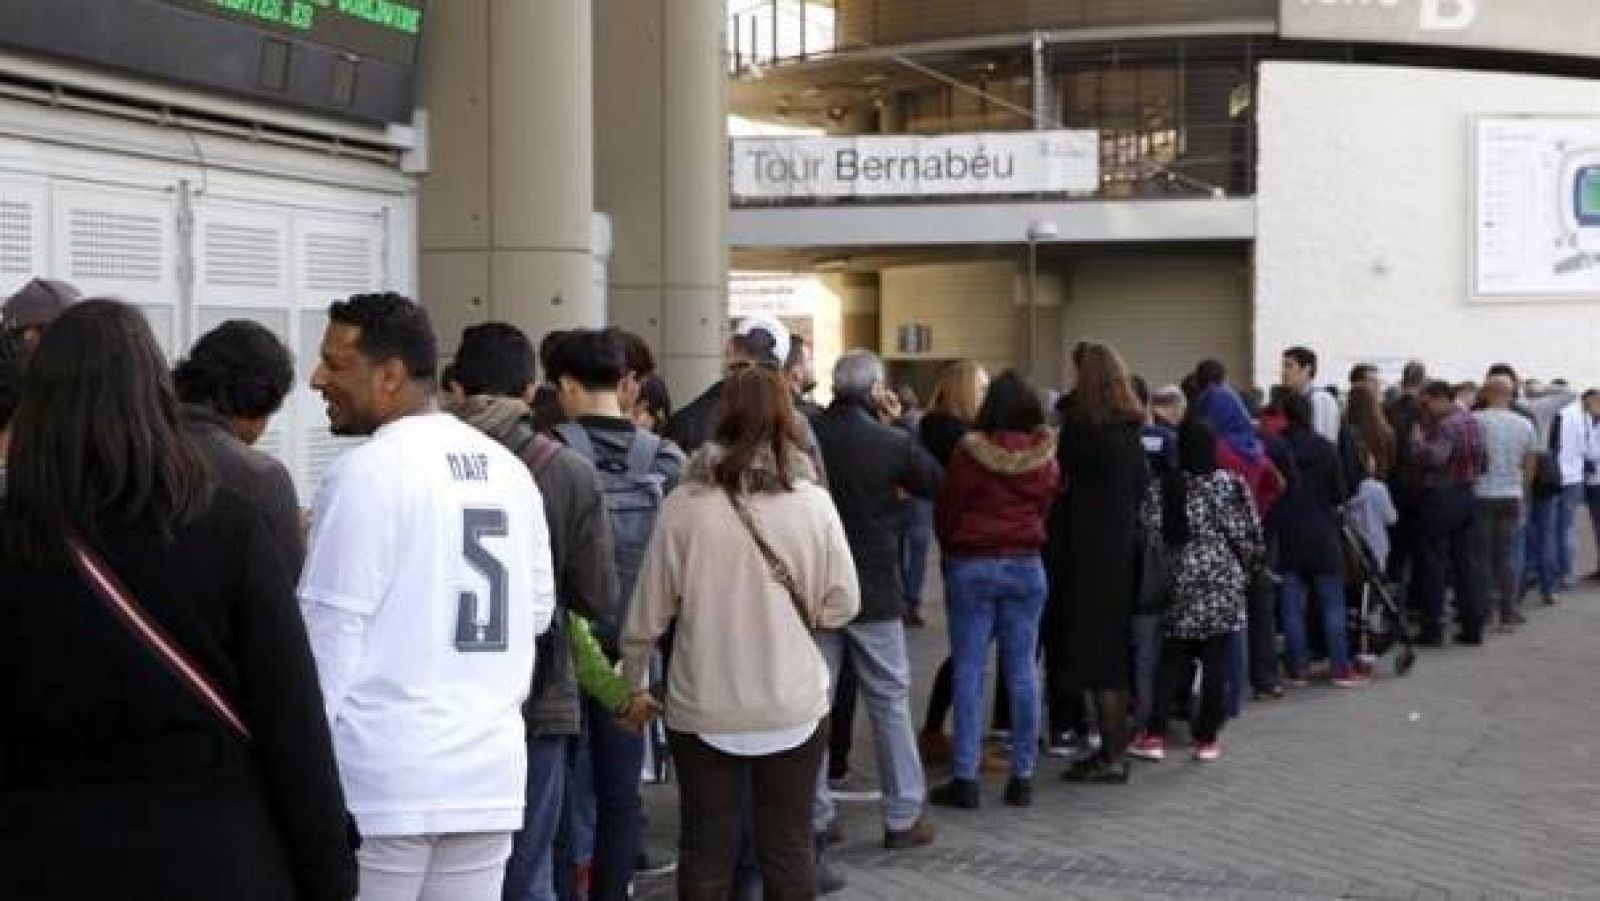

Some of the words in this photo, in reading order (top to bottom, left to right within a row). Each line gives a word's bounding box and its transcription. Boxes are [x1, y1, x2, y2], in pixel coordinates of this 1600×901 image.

[747, 149, 824, 182] Tour
[835, 143, 1014, 182] Bernabéu
[455, 507, 509, 652] 5
